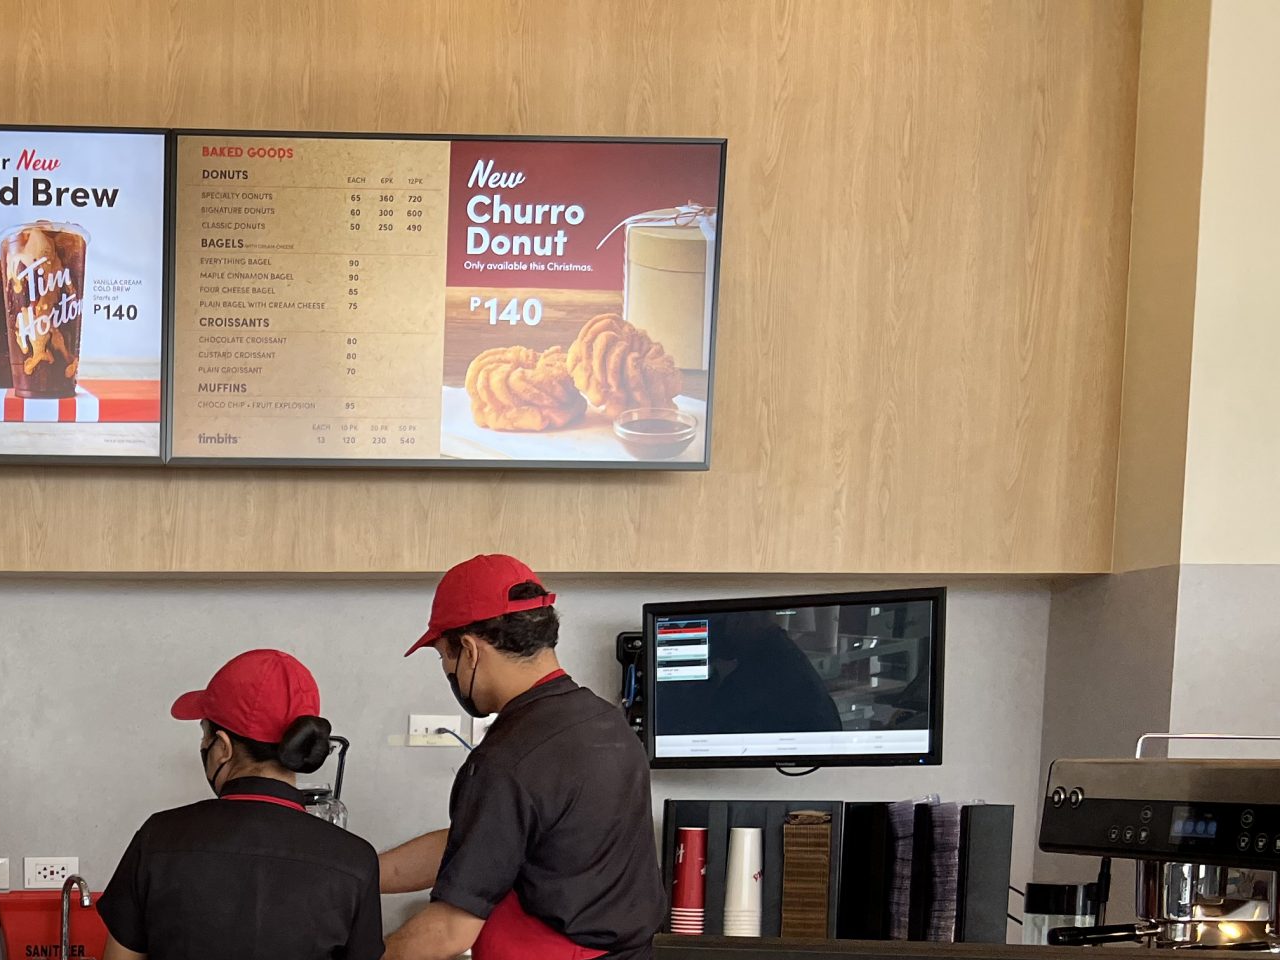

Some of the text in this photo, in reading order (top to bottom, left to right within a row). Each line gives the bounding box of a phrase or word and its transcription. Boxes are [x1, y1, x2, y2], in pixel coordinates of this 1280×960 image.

[202, 147, 293, 159] BAKED GOODS
[16, 149, 61, 172] New
[202, 170, 248, 180] DONUTS
[467, 160, 525, 189] New
[33, 178, 119, 208] Brew
[202, 192, 240, 200] SPECIALTY
[351, 194, 361, 202] 65
[466, 195, 585, 225] Churro
[201, 239, 244, 248] BAGELS
[466, 227, 567, 256] Donut
[464, 261, 593, 272] Only available this Christmas.
[17, 256, 71, 301] Tim
[94, 304, 138, 321] P140
[470, 297, 542, 326] P140
[199, 318, 269, 328] CROISSANTS
[199, 336, 244, 344] CHOCOLATE
[198, 384, 247, 393] MUFFINS
[198, 433, 238, 444] timbits
[25, 944, 85, 957] SANITER
